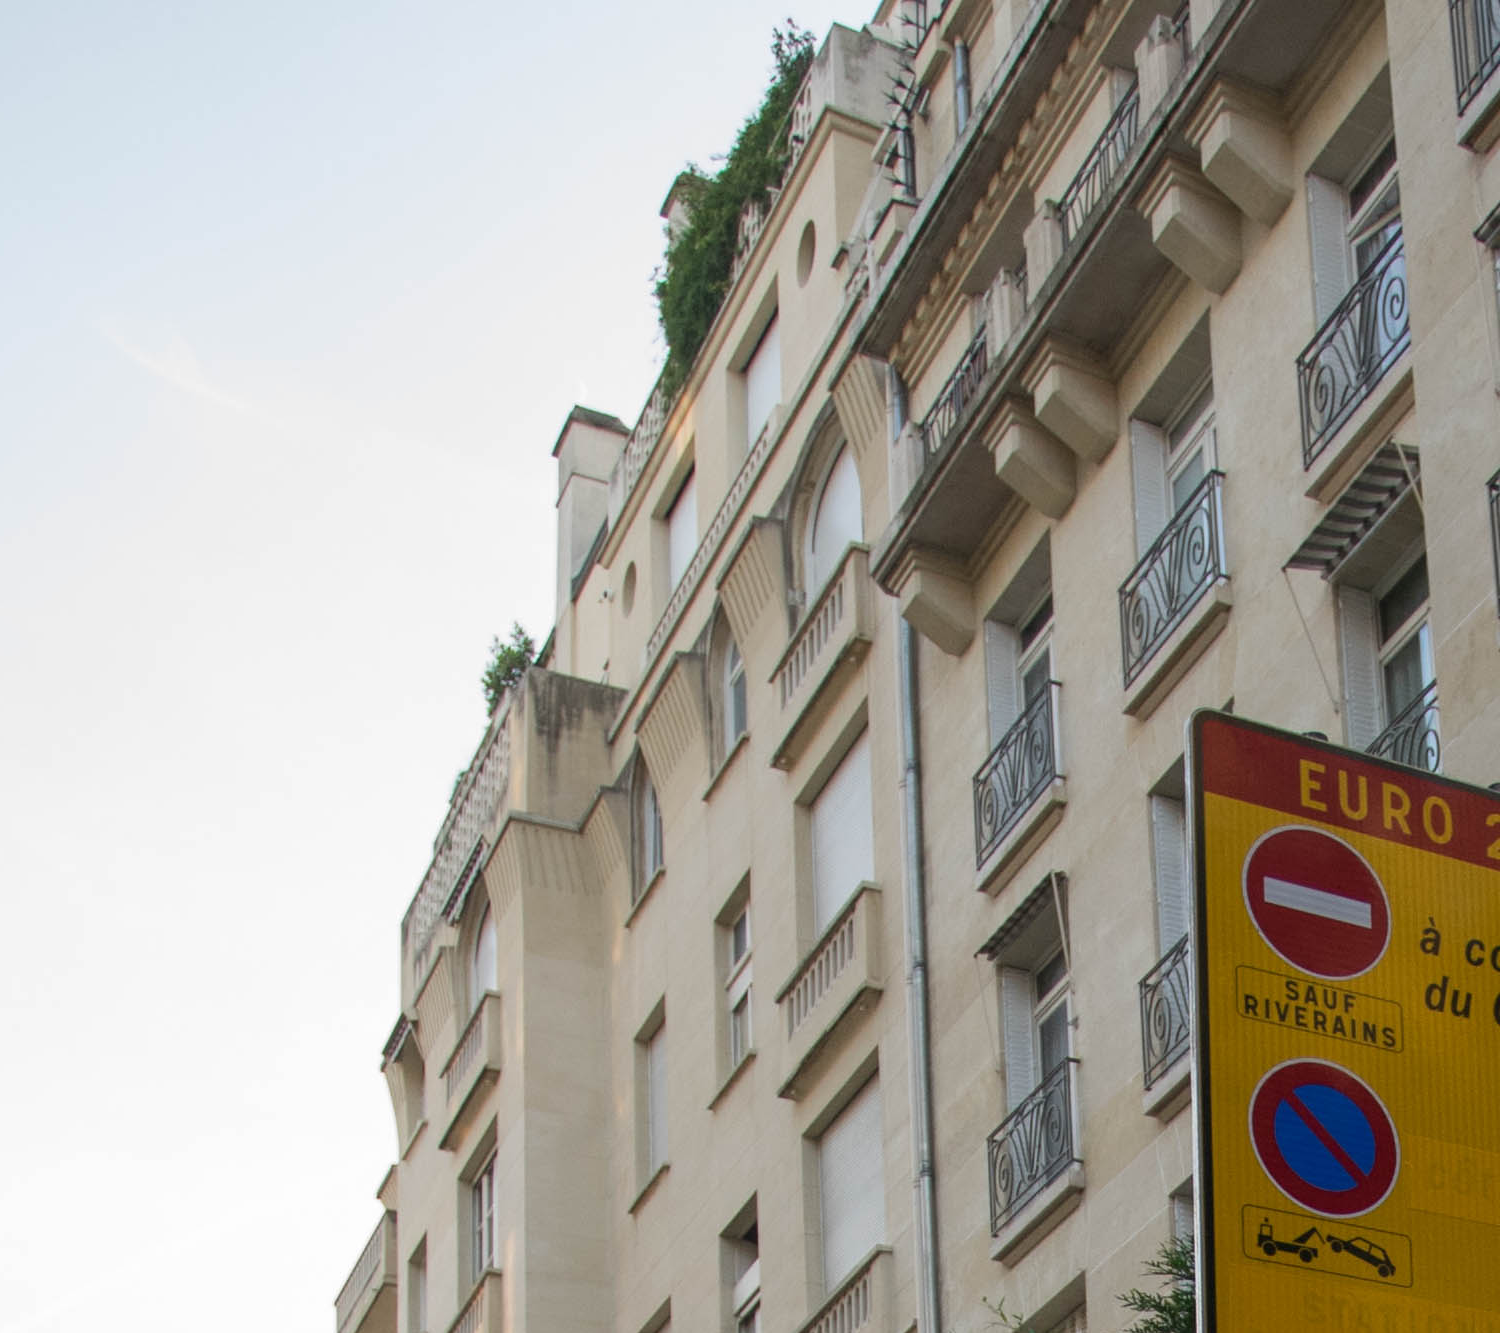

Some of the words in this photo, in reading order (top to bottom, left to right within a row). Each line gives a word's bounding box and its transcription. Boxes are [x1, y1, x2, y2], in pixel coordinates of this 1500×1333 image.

[1299, 758, 1454, 845] EURO
[1419, 916, 1442, 957] à
[1284, 979, 1357, 1015] SAUF
[1424, 975, 1472, 1019] du
[1244, 994, 1398, 1049] RIVERAINS
